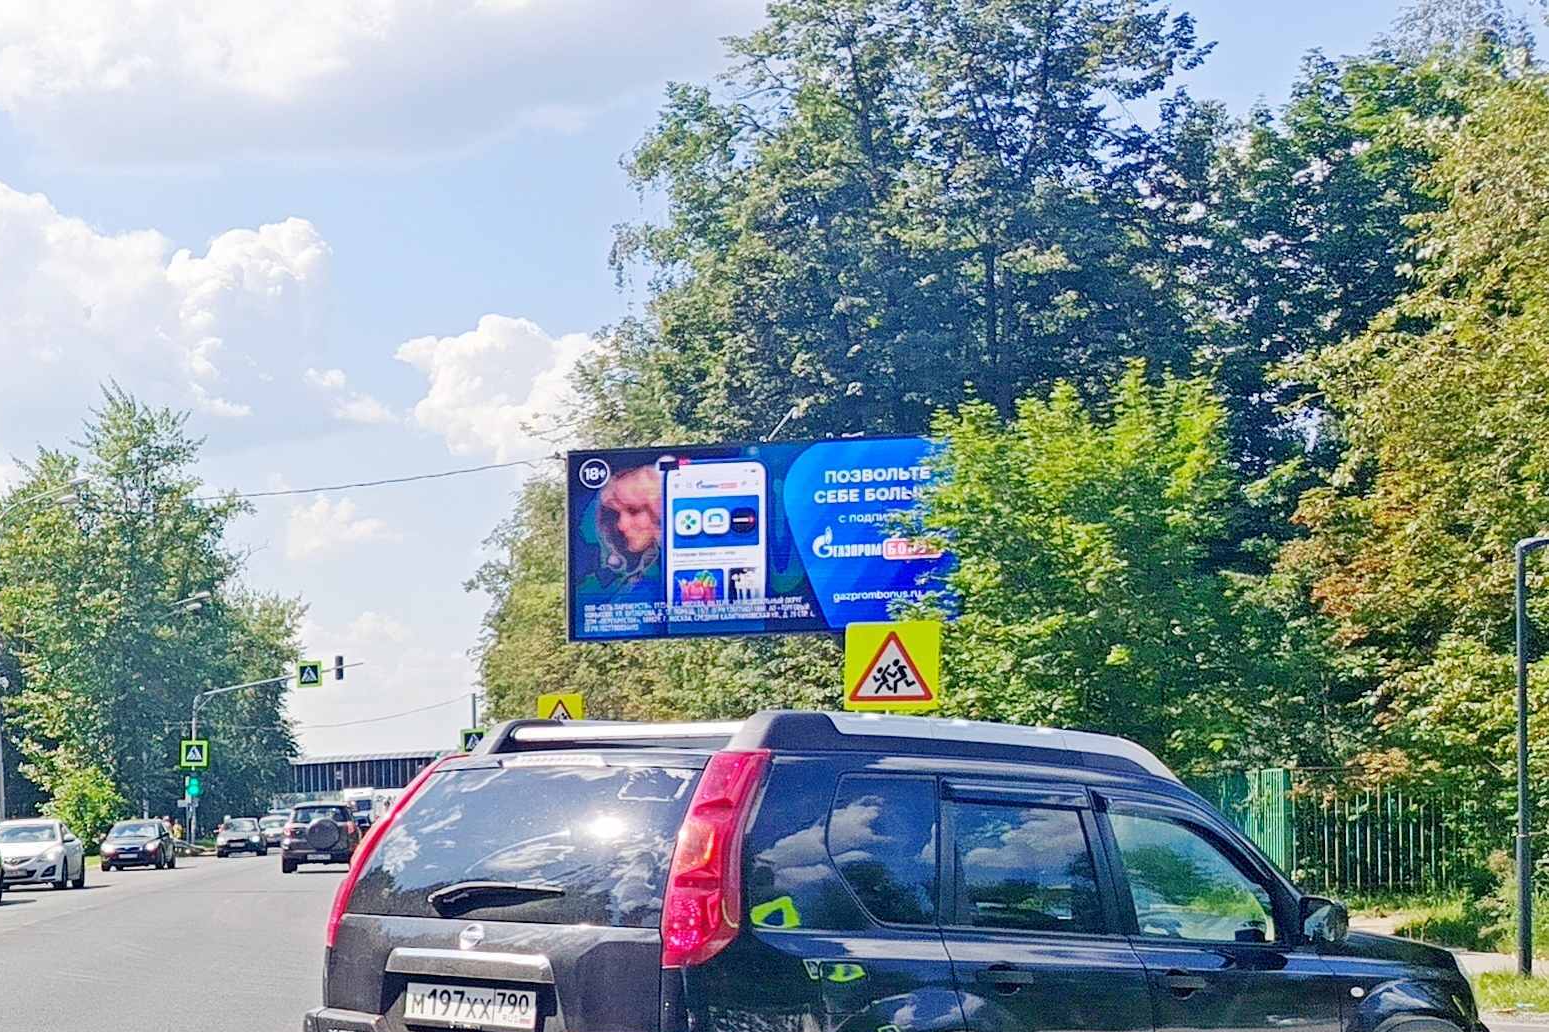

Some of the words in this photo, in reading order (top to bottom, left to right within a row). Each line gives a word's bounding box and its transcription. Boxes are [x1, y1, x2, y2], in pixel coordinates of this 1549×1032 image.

[584, 467, 606, 480] 18+
[824, 466, 931, 484] ПОЗВОЛЬТЕ
[814, 488, 860, 504] СЕБЕ
[864, 485, 926, 502] БОЛЬ
[831, 543, 883, 557] ГАЗПРОМ
[833, 588, 923, 603] gazprombonus.ru
[411, 988, 491, 1020] М197ХХ
[496, 991, 529, 1015] 790
